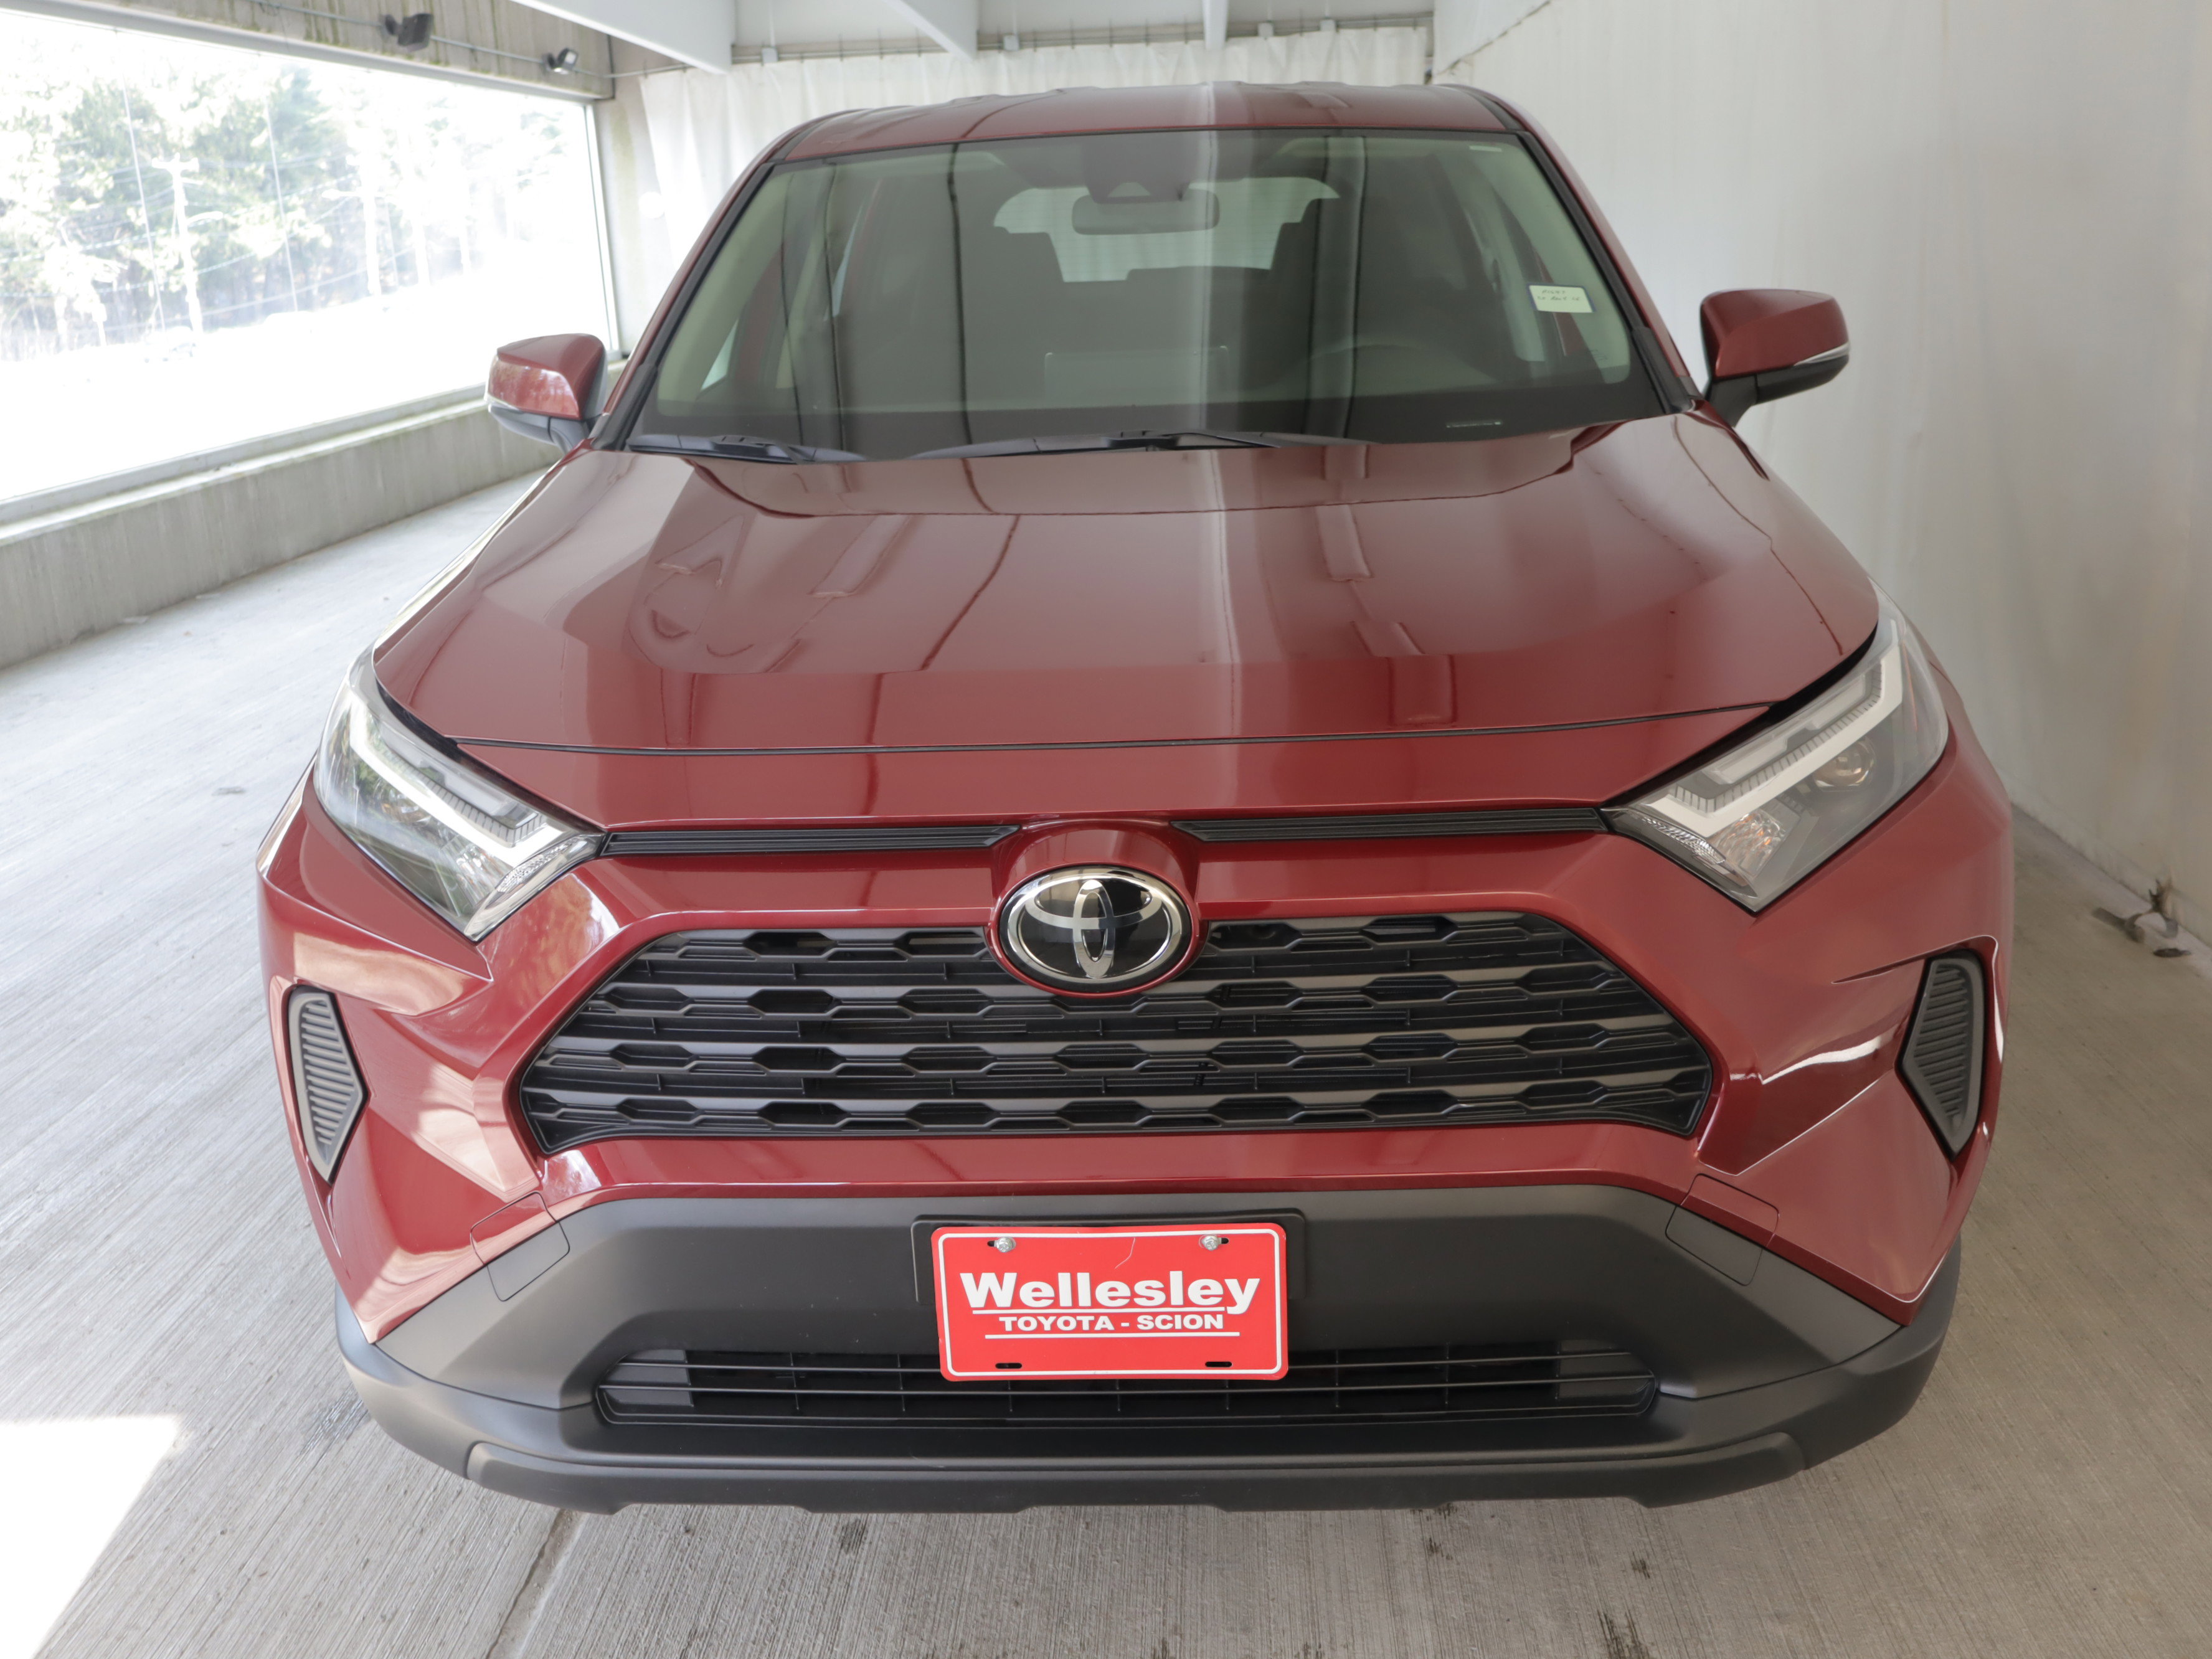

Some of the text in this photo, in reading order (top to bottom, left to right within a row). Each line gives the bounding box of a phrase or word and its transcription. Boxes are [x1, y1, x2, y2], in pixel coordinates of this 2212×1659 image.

[960, 1270, 1260, 1315] Wellesley
[998, 1315, 1115, 1331] TOYOTA
[1137, 1314, 1224, 1330] SCION
